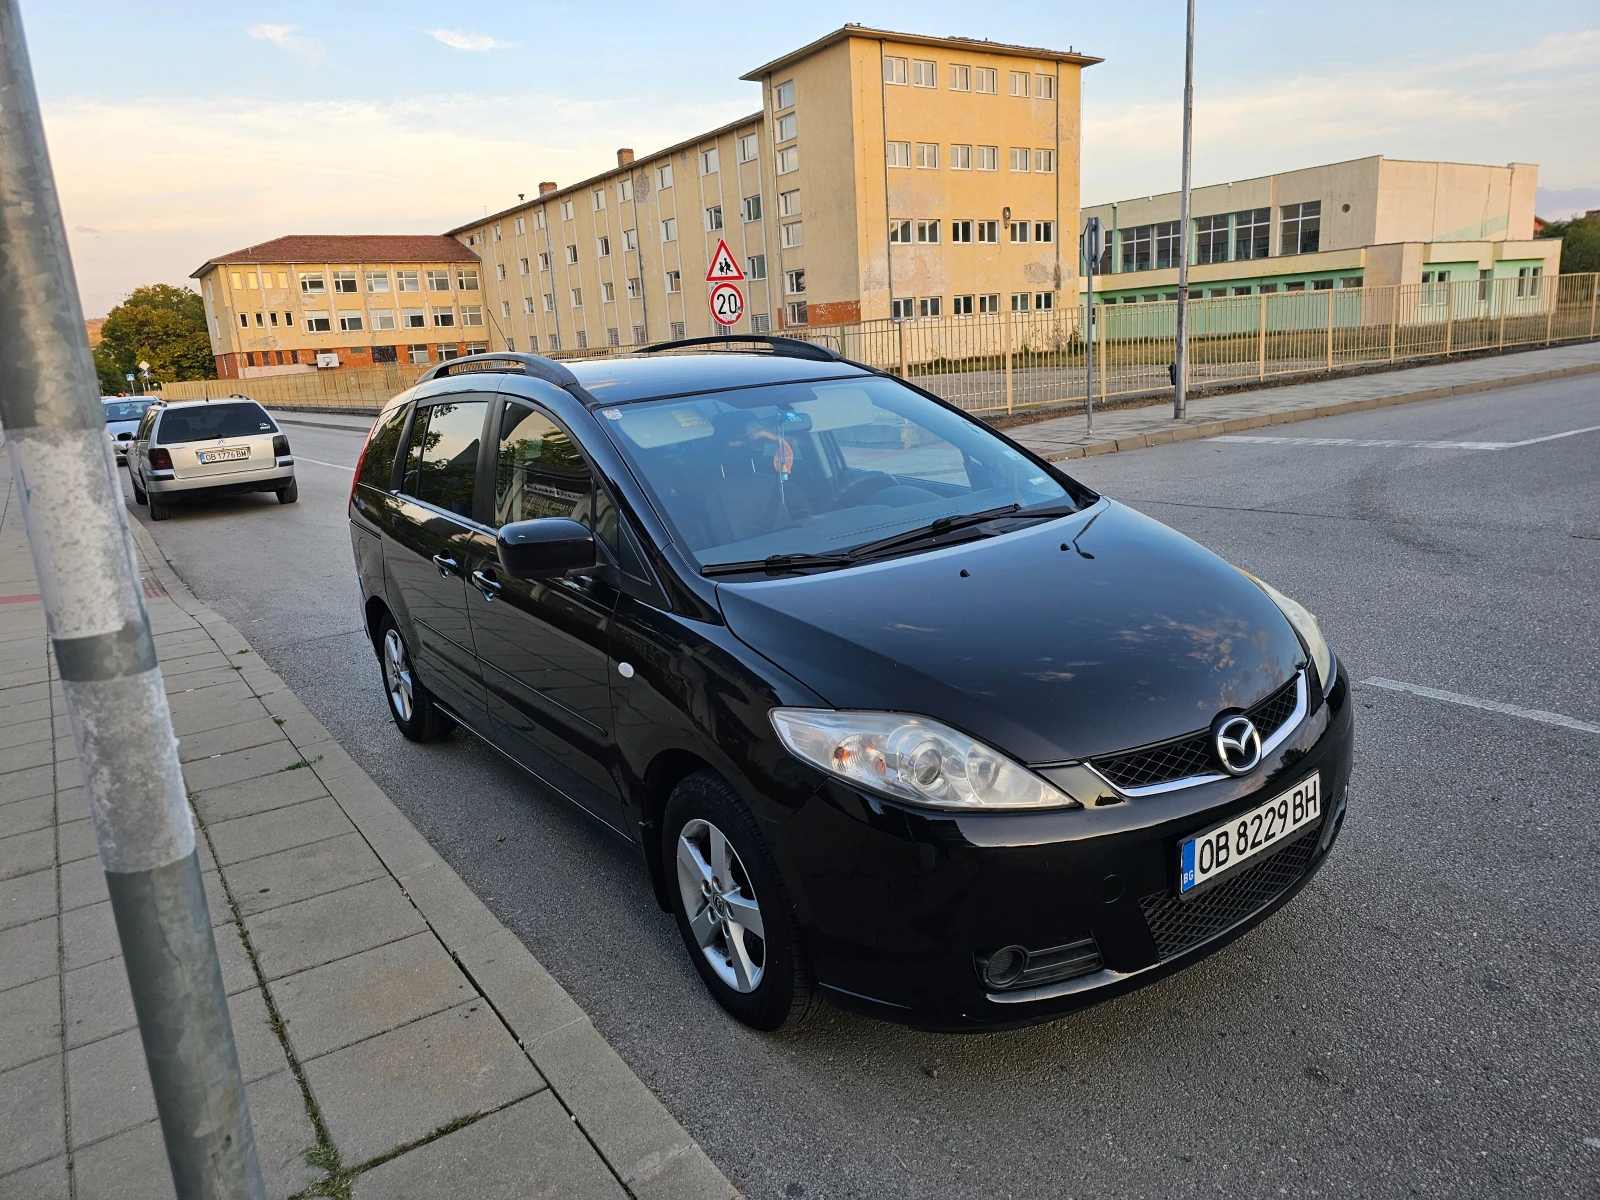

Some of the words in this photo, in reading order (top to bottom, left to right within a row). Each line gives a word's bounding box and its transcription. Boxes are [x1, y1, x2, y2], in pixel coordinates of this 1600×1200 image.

[717, 294, 737, 314] 20
[205, 453, 216, 461] OB
[218, 451, 235, 460] 1776
[1199, 830, 1230, 874] OB
[1236, 799, 1288, 856] 8229
[1292, 780, 1317, 825] BH
[1183, 870, 1194, 884] BG
